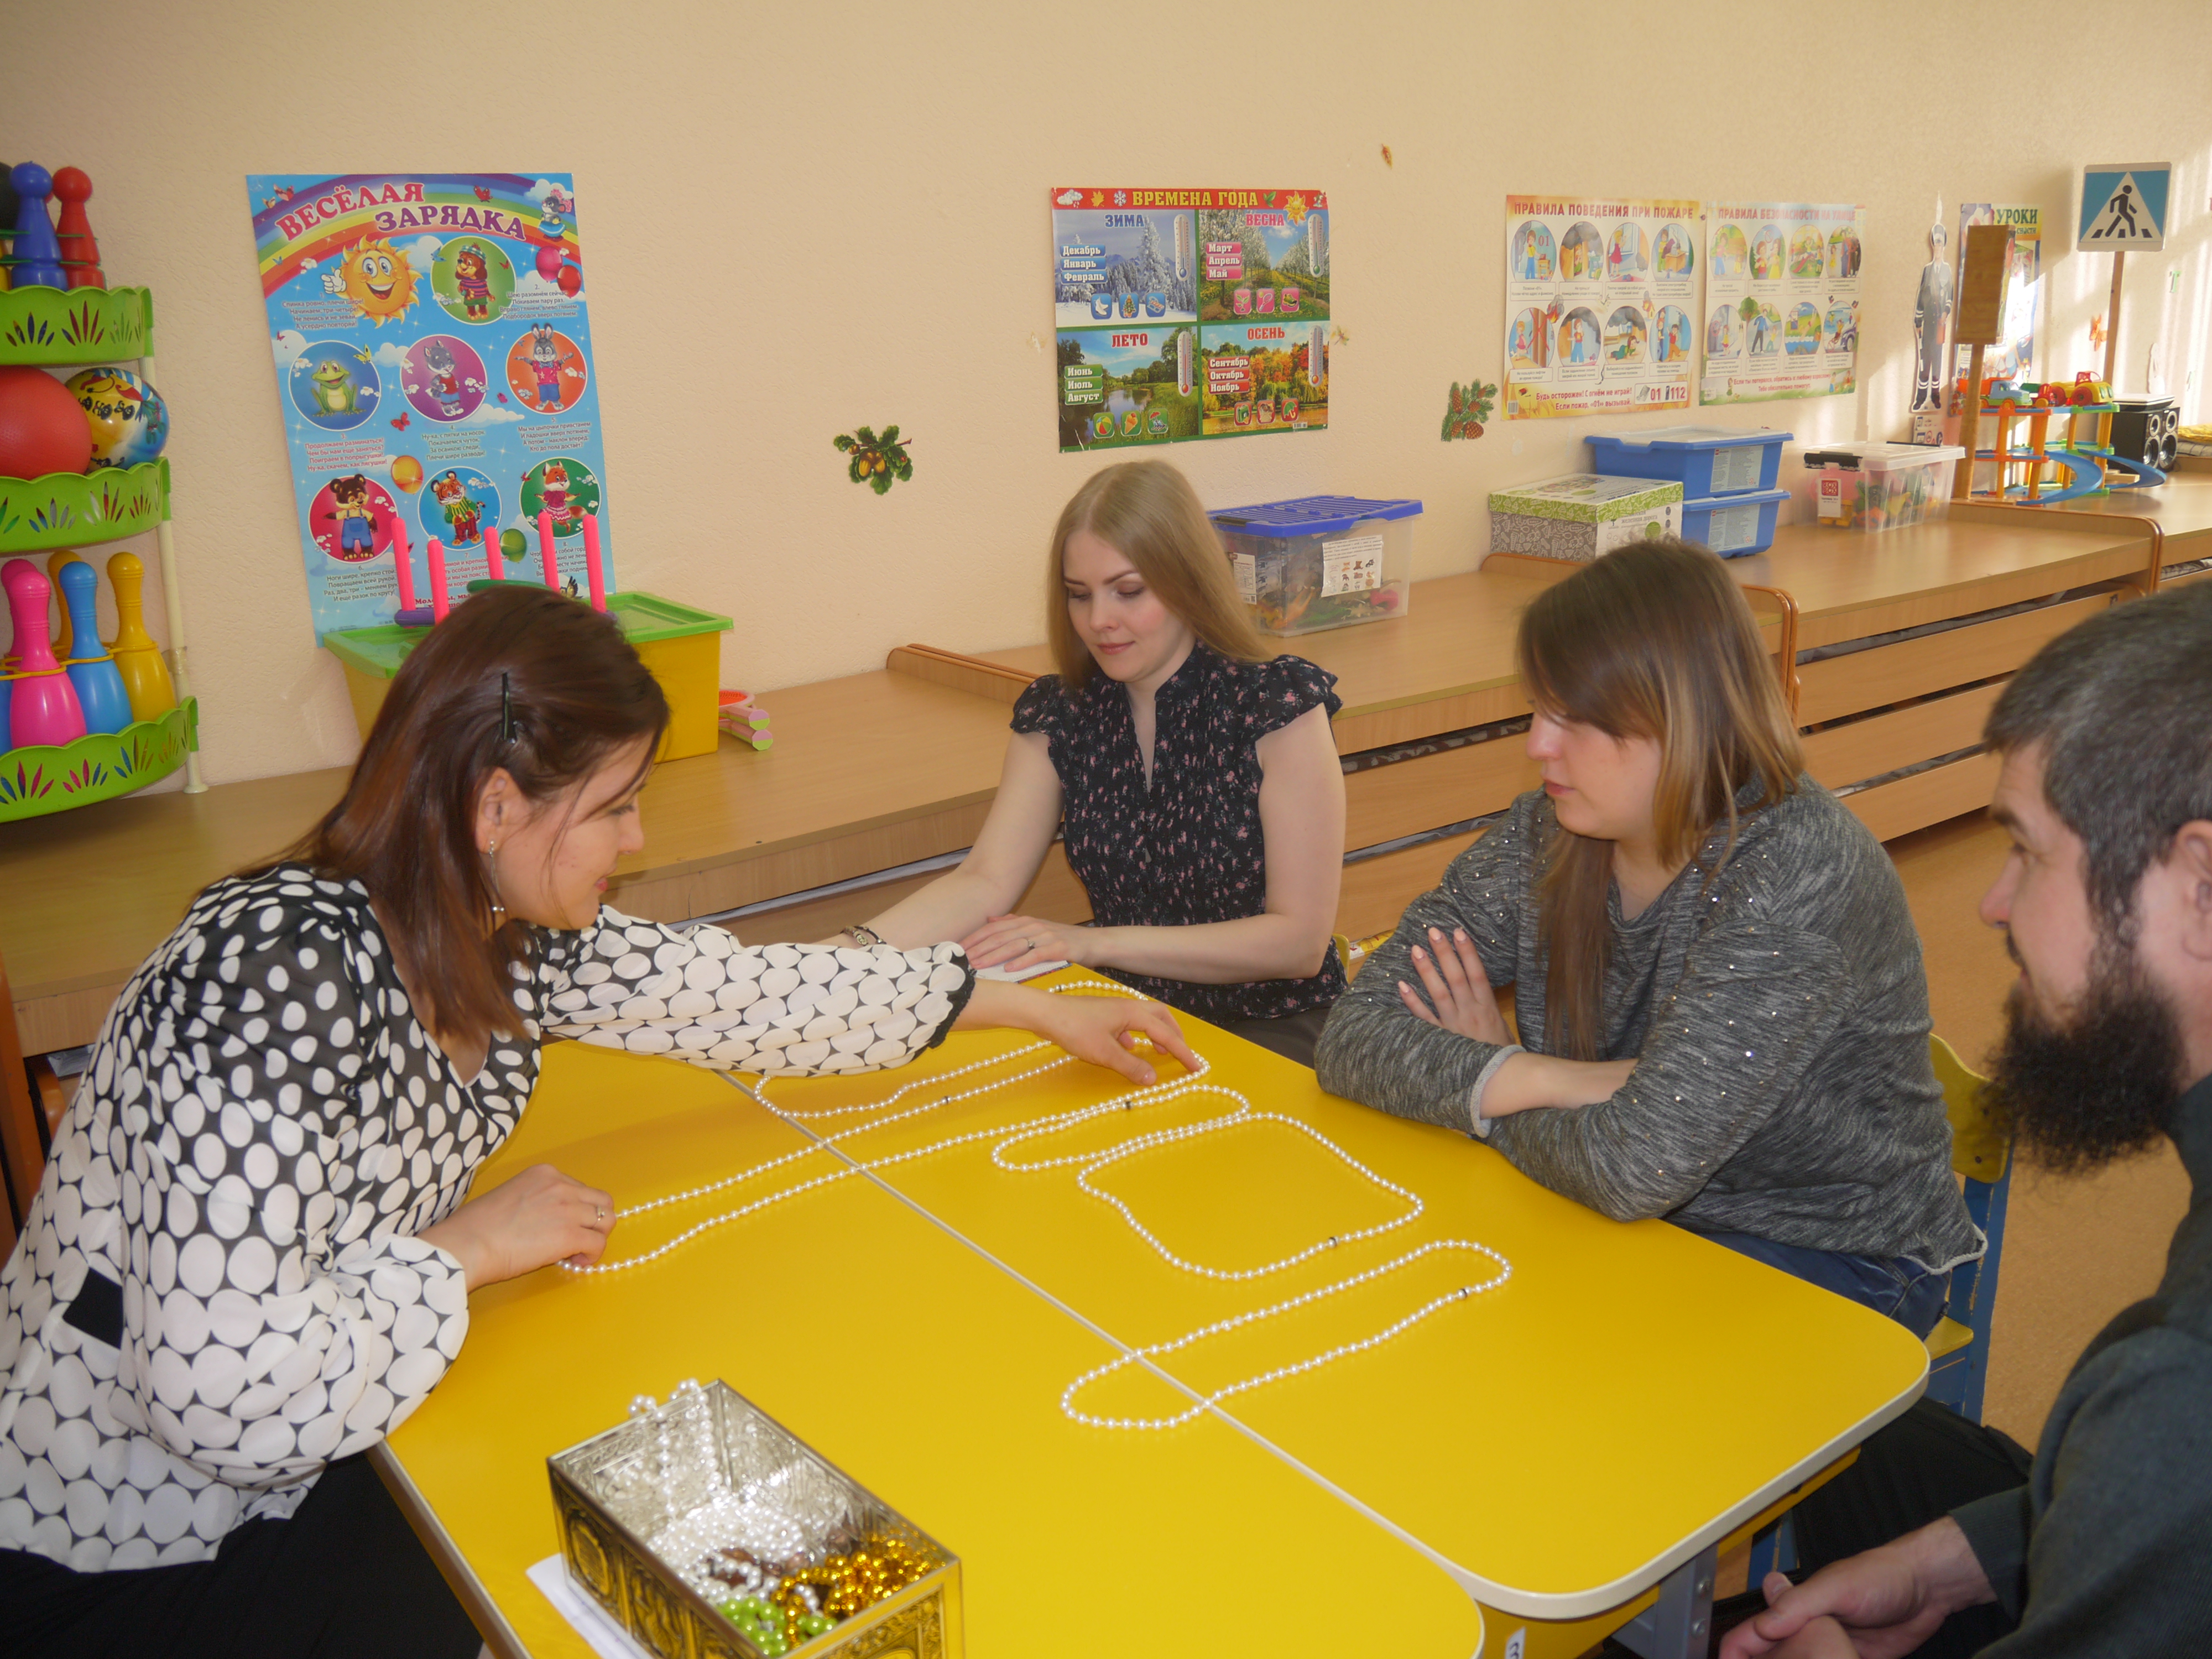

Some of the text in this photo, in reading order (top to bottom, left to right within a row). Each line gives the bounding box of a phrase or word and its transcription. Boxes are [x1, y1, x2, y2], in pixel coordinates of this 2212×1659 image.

[1133, 191, 1258, 208] ВРЕМЕНА ГОДА
[275, 183, 424, 241] ВЕСЁЛАЯ
[1515, 202, 1693, 219] ПРАВИЛА ПОВЕДЕНИЯ ПРИ ПОЖАРЕ
[1719, 208, 1856, 222] ПРАВИЛА БЕЗОПАСНОСТИ НА УЛИЦЕ
[1105, 214, 1144, 228] ЗИМА
[1246, 213, 1285, 226] ВЕСНА
[1996, 209, 2038, 224] УРОКИ
[375, 205, 526, 240] ЗАРЯДКА
[1063, 246, 1101, 256] Декабрь
[1208, 244, 1232, 253] Март
[1063, 259, 1097, 269] Январь
[1209, 257, 1240, 267] Апрель
[1064, 273, 1104, 283] Февраль
[1209, 269, 1228, 278] Май
[1248, 327, 1285, 340] ОСЕНЬ
[1112, 333, 1148, 348] ЛЕТО
[1210, 358, 1248, 368] Сентябрь
[1067, 367, 1093, 377] Июнь
[1210, 371, 1244, 380] Октябрь
[1067, 380, 1093, 390] Июль
[1210, 383, 1239, 393] Ноябрь
[1068, 393, 1099, 403] Август
[1536, 392, 1550, 400] Будь
[1551, 392, 1584, 400] осторожен!
[1589, 389, 1605, 398] огнём
[1614, 388, 1632, 397] играй!
[1651, 388, 1661, 401] 01
[1670, 387, 1686, 399] 112
[1556, 402, 1569, 410] Если
[1571, 401, 1589, 410] пожар,
[345, 438, 384, 446] разминаться!
[345, 452, 384, 461] попрыгушки!
